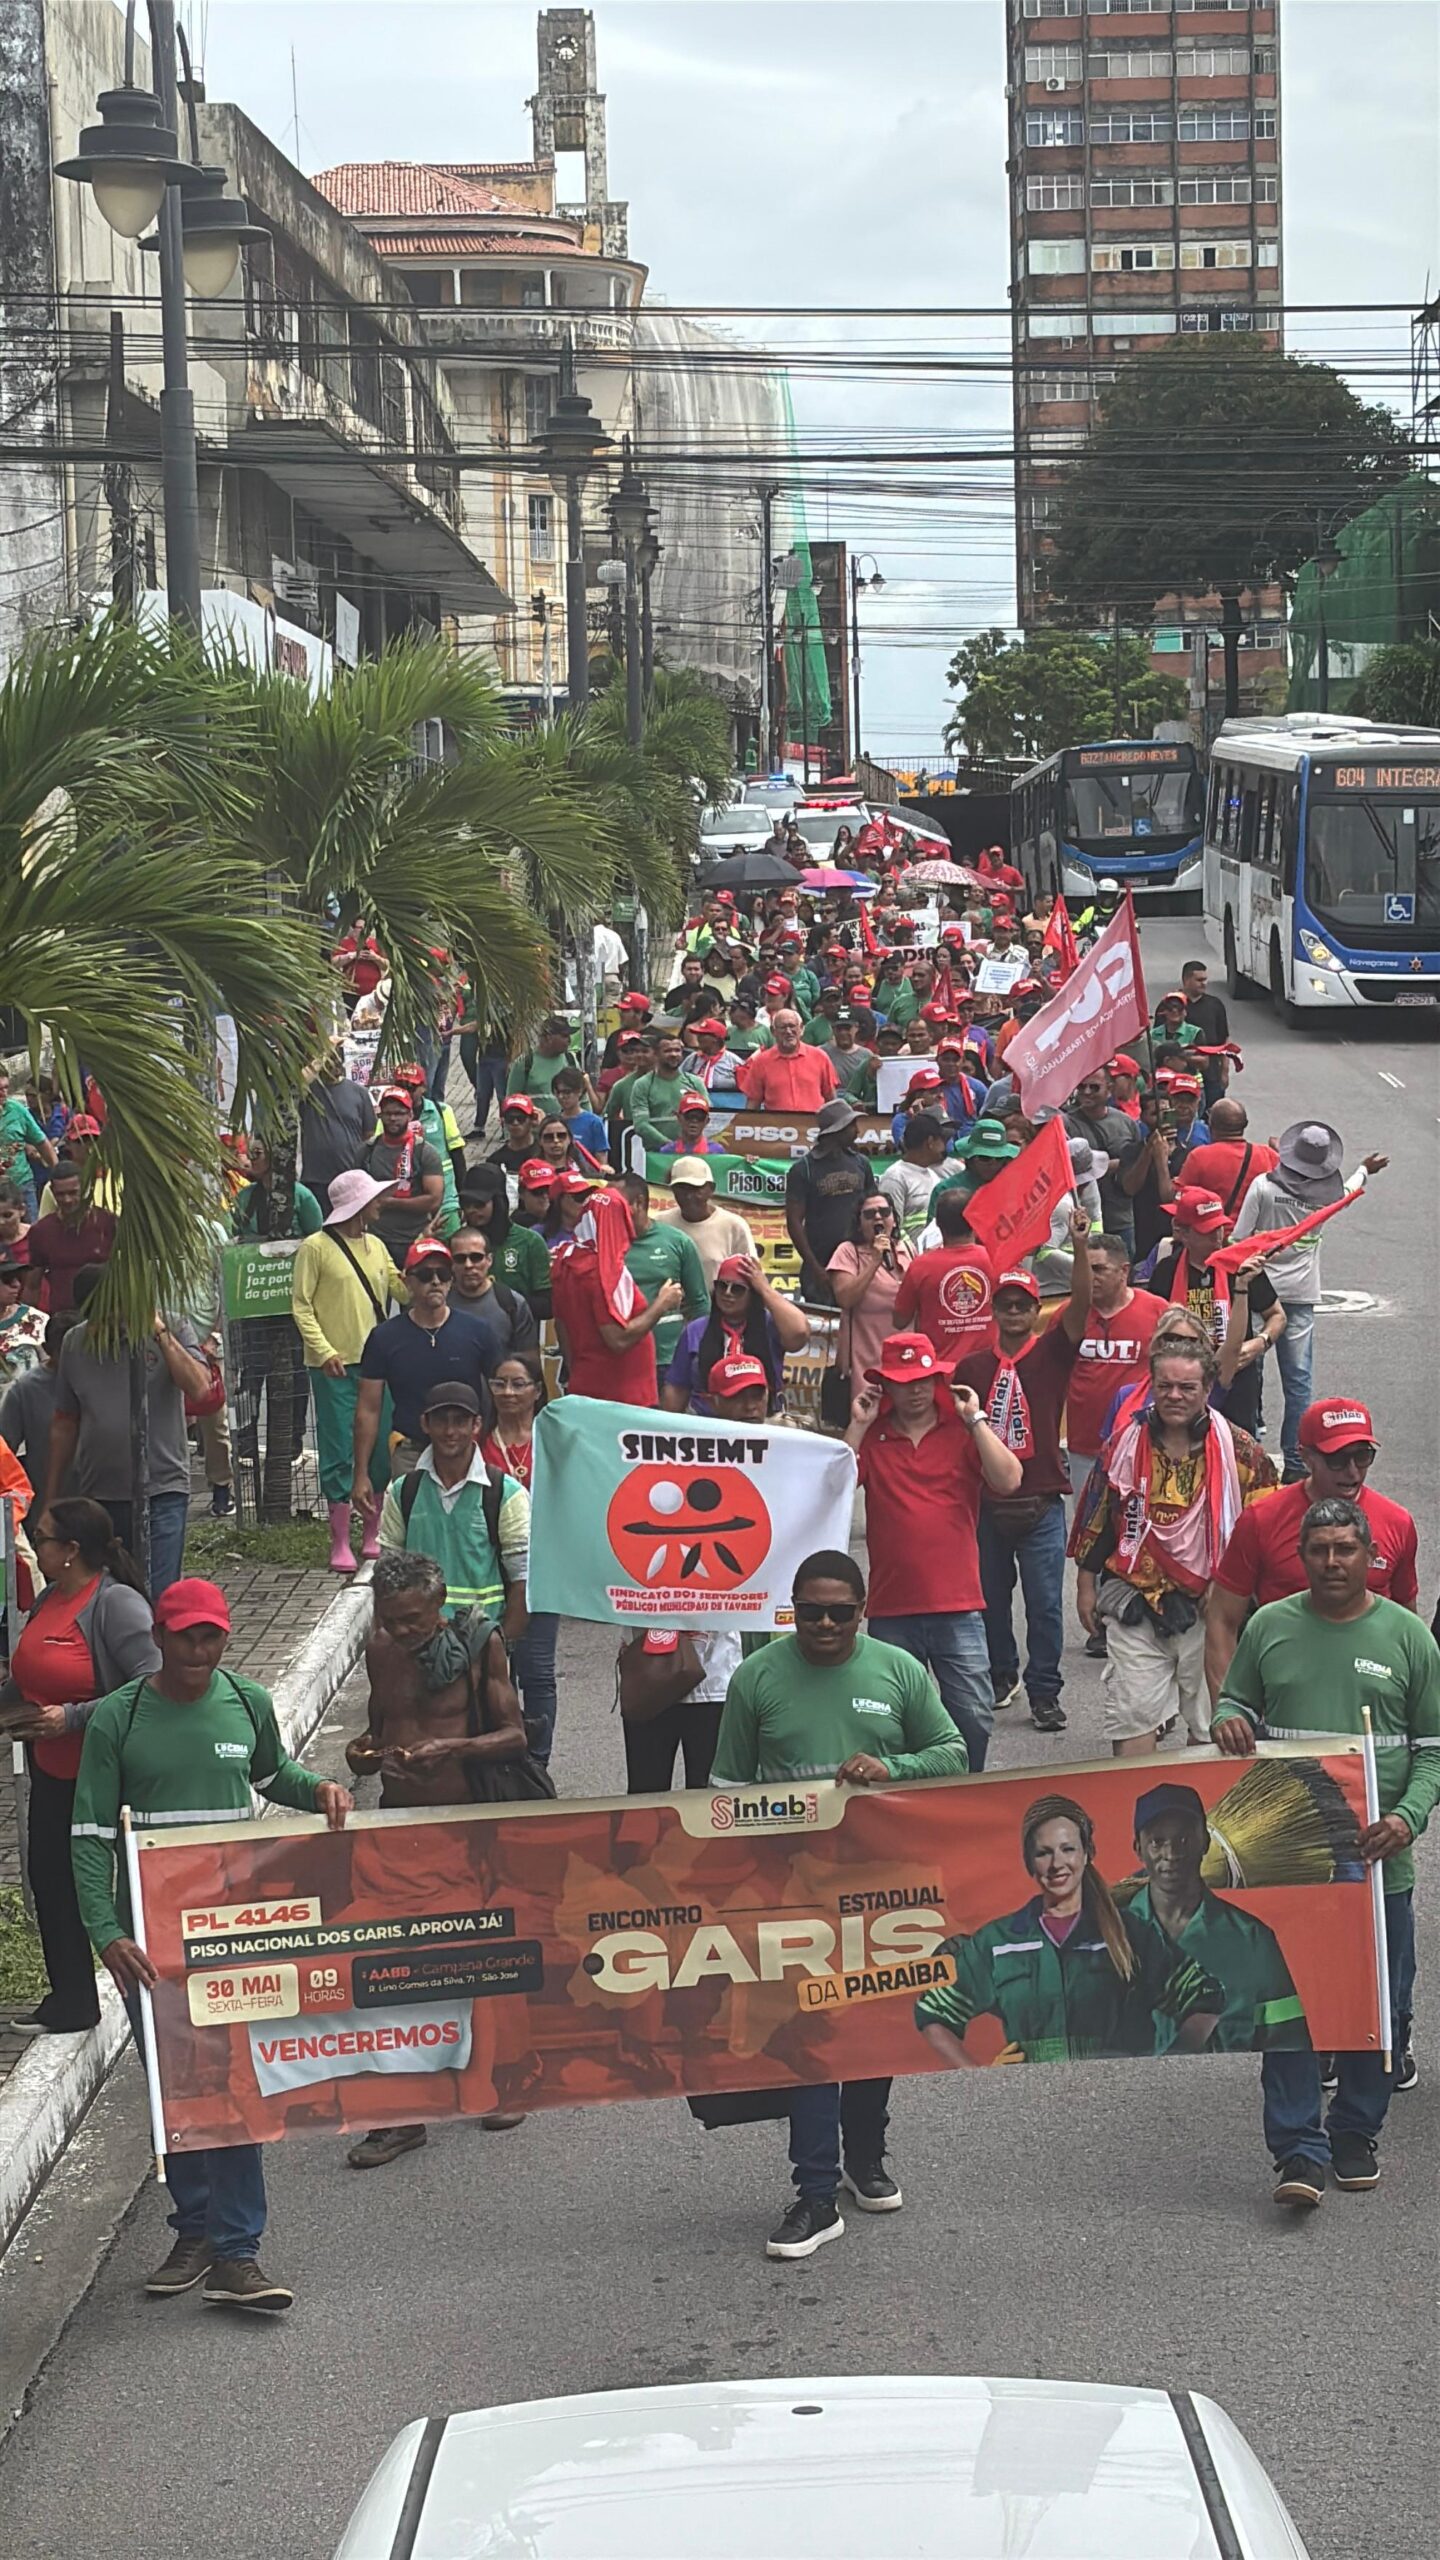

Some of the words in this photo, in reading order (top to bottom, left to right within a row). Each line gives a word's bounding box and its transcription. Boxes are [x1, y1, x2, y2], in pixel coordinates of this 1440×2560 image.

[1336, 767, 1365, 787] 604
[1349, 959, 1398, 968] Navegantes
[735, 1125, 798, 1143] PISO
[728, 1171, 763, 1192] Piso
[247, 1263, 255, 1273] O
[258, 1260, 292, 1272] verde
[246, 1276, 266, 1288] faz
[268, 1273, 292, 1286] part
[245, 1290, 259, 1299] da
[1079, 1338, 1134, 1359] CUT
[622, 1434, 768, 1464] SINSEMT
[610, 1588, 669, 1600] SINDICATO
[673, 1589, 696, 1600] DOS
[699, 1592, 768, 1600] SERVIDORES
[616, 1599, 657, 1612] PÚBLICOS
[659, 1602, 708, 1612] MUNICIPAIS
[710, 1602, 723, 1611] DE
[724, 1602, 762, 1611] TAVARES
[711, 1794, 806, 1830] Sintab
[838, 1885, 945, 1914] ESTADUAL
[187, 1912, 230, 1932] PL
[234, 1904, 311, 1927] 4146
[588, 1904, 702, 1932] ENCONTRO
[190, 1942, 228, 1959] PISO
[231, 1933, 315, 1955] NACIONAL
[317, 1930, 351, 1946] DOS
[353, 1926, 406, 1941] GARIS.
[409, 1917, 476, 1937] APROVA
[478, 1912, 503, 1929] JÁ!
[589, 1908, 946, 1994] GARIS
[422, 1960, 483, 1976] Campina
[485, 1953, 535, 1968] Grande
[206, 1979, 234, 2000] 30
[242, 1974, 282, 1996] MAI
[309, 1968, 338, 1989] 09
[399, 1980, 429, 1991] Gomes
[430, 1978, 442, 1987] da
[499, 1971, 519, 1980] José
[806, 1980, 840, 2005] DA
[844, 1959, 950, 1998] PARAÍBA
[208, 1995, 284, 2014] SEXTA-FEIRA
[304, 1988, 345, 2004] HORAS
[258, 2021, 460, 2064] VENCEREMOS
